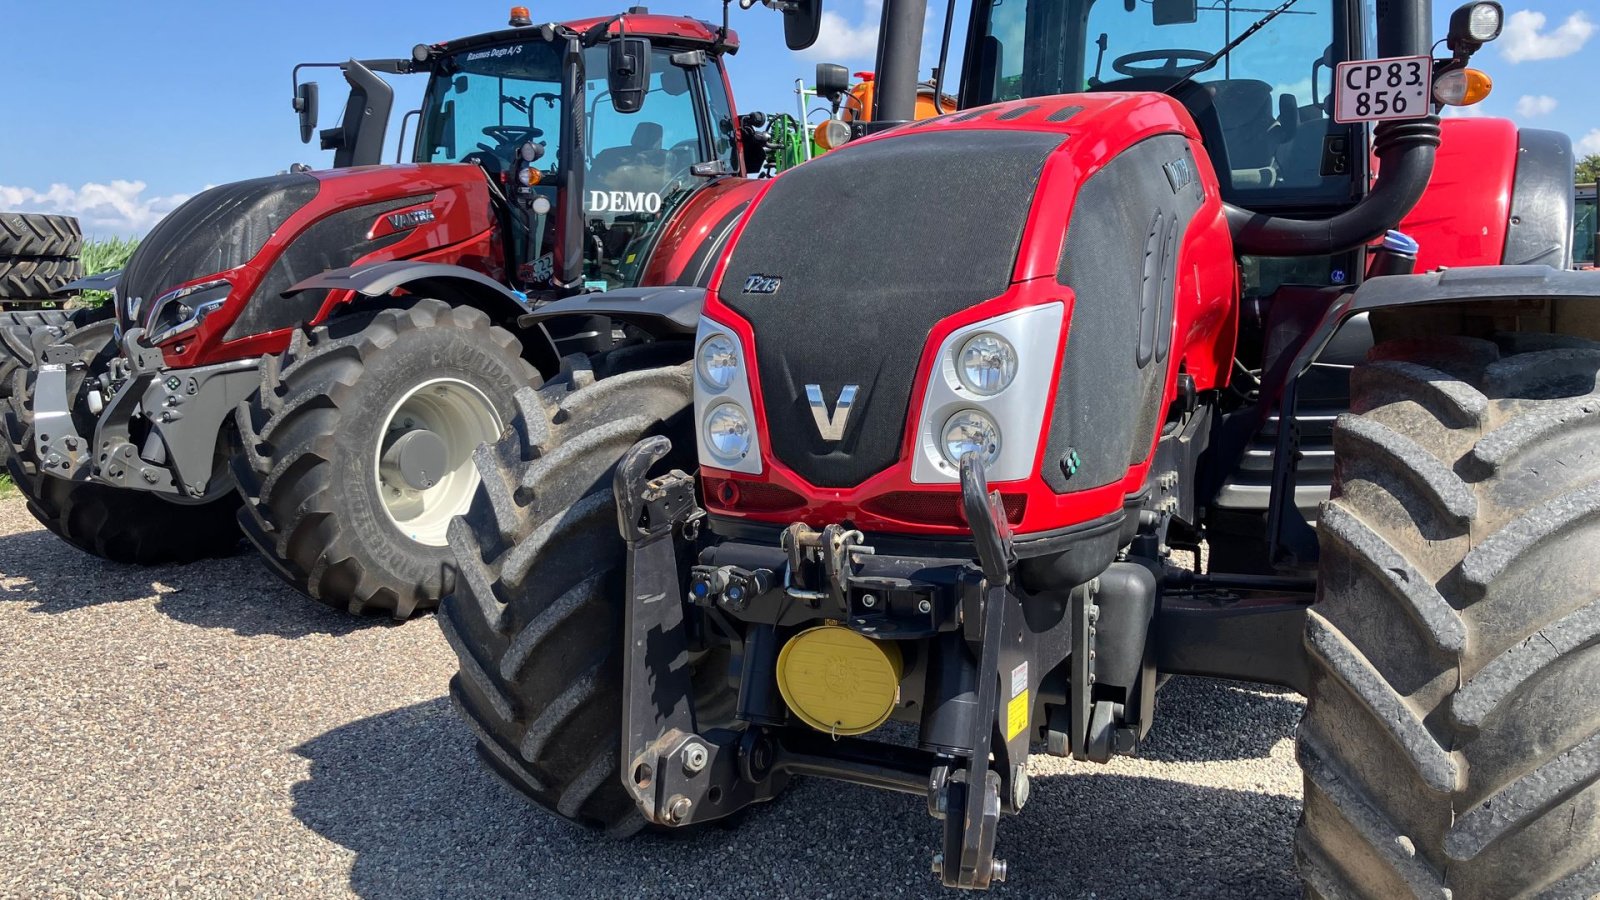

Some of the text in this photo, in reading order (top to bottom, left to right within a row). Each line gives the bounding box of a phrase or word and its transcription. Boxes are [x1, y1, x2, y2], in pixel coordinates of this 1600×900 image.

[466, 45, 523, 61] Rasmus Degn A/S
[1355, 90, 1407, 117] 856
[589, 190, 662, 213] DEMO
[804, 383, 859, 441] V
